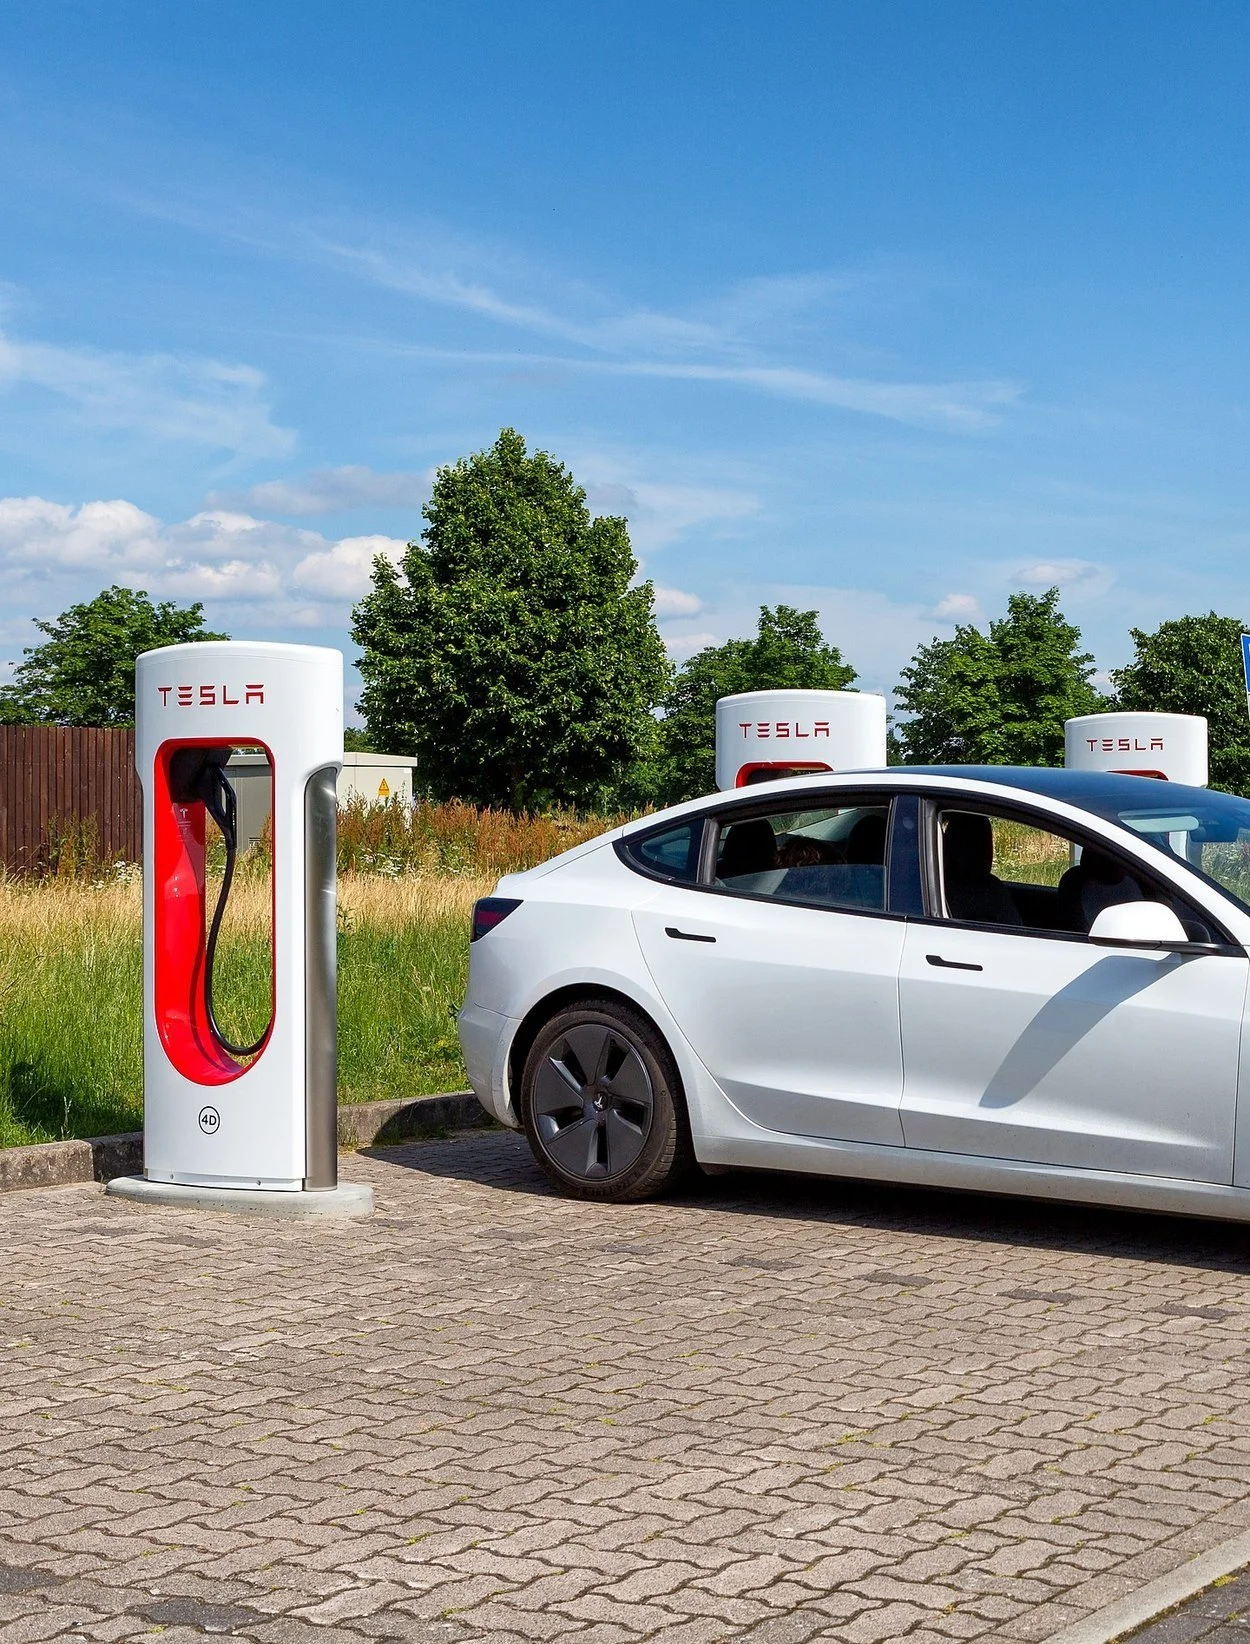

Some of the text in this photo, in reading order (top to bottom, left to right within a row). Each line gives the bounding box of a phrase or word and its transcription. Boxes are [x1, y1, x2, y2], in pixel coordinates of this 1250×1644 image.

[157, 684, 265, 707] TESLA
[738, 721, 831, 739] TESLA
[1085, 738, 1165, 752] TESLA
[201, 1114, 217, 1126] 4D
